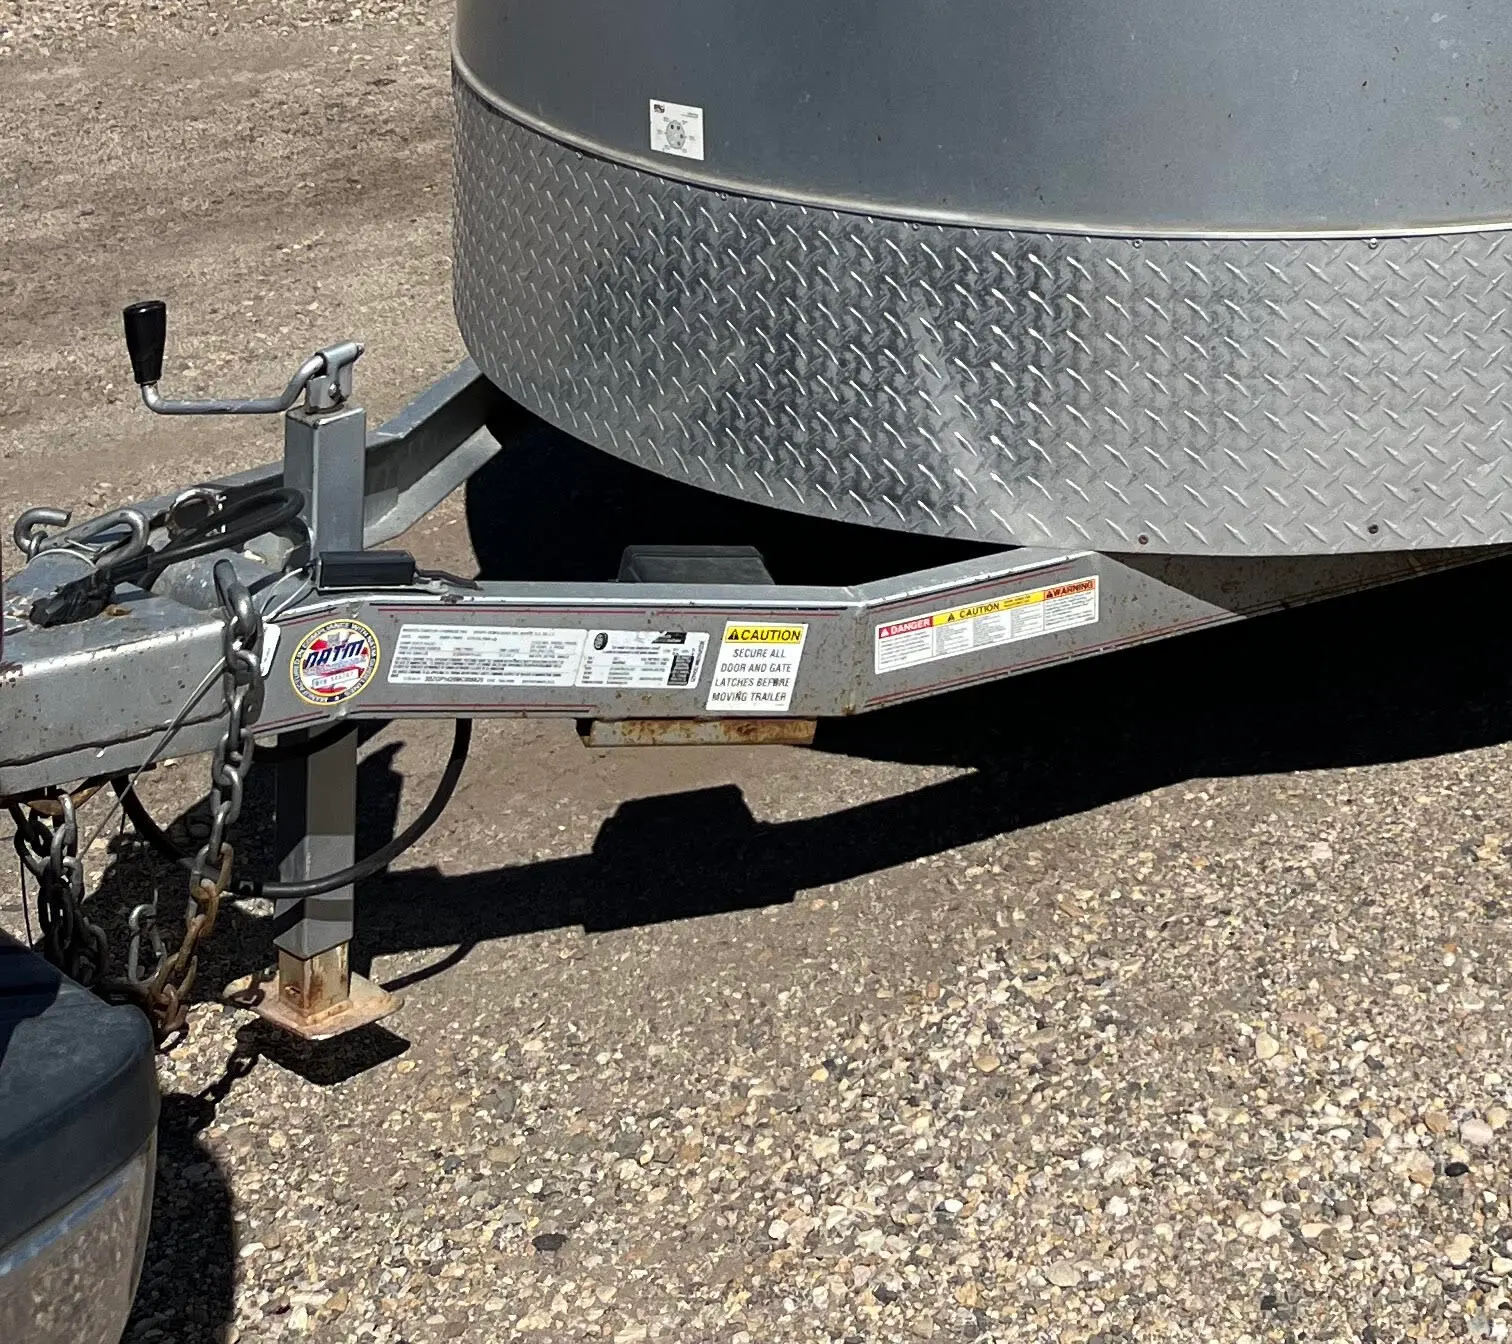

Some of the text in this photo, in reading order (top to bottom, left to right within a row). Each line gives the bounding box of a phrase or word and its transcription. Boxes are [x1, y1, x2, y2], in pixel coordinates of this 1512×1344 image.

[1053, 580, 1094, 597] WARNING
[959, 603, 1000, 619] CAUTION
[890, 617, 931, 635] DANGER
[740, 629, 801, 640] CAUTION
[733, 648, 786, 658] SECURE ALL
[721, 663, 792, 673] DOOR AND GATE
[715, 677, 791, 687] LATCHES BEFORE
[712, 692, 787, 702] MOVING TRAILER
